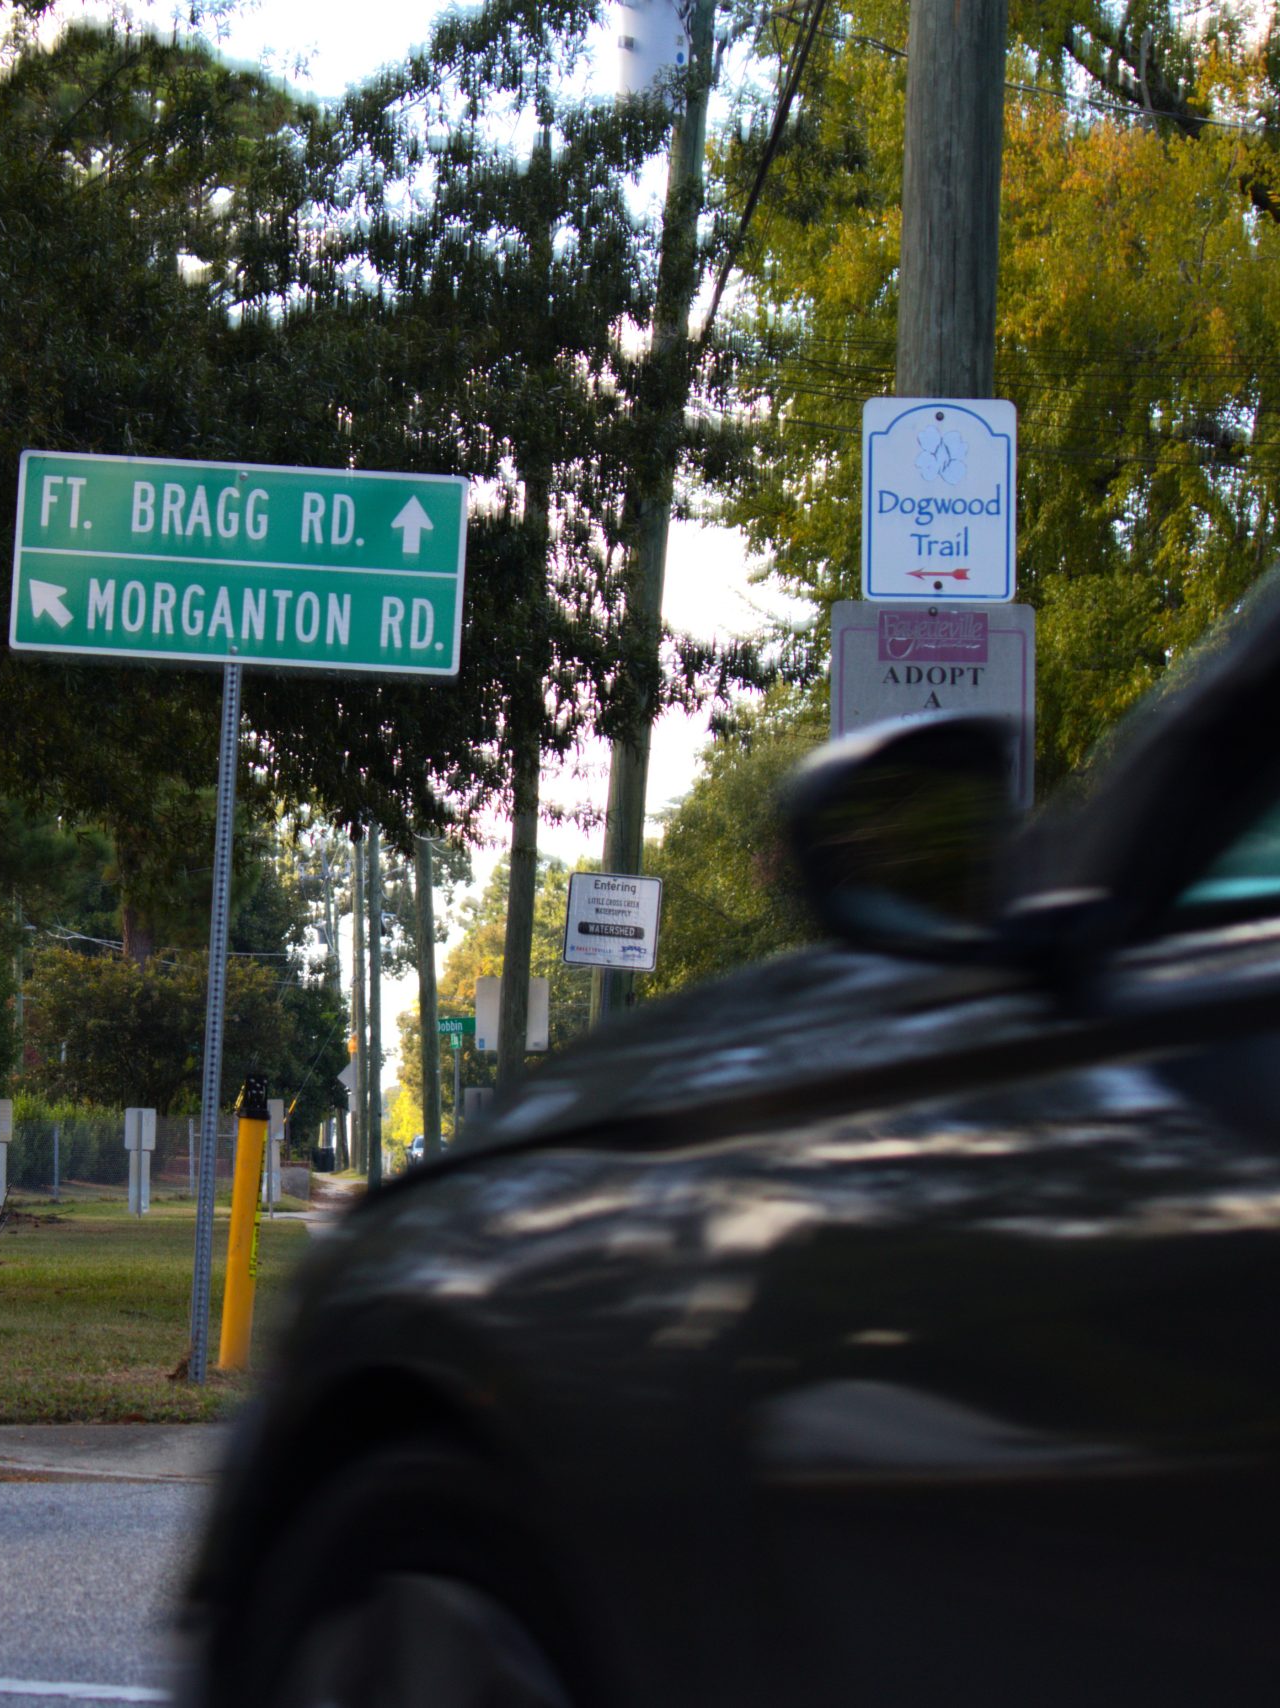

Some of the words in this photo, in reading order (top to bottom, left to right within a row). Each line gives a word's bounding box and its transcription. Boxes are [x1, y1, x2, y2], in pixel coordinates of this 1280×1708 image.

[39, 475, 93, 530] FT.
[130, 480, 269, 541] BRAGG
[300, 491, 365, 547] RD.
[877, 483, 1001, 525] Dogwood
[909, 526, 969, 557] Trail
[86, 577, 352, 646] MORGANTON
[379, 595, 445, 652] RD.
[882, 666, 985, 686] ADOPT
[923, 690, 942, 708] A
[594, 880, 636, 894] Entering
[588, 924, 635, 937] WATERSHED
